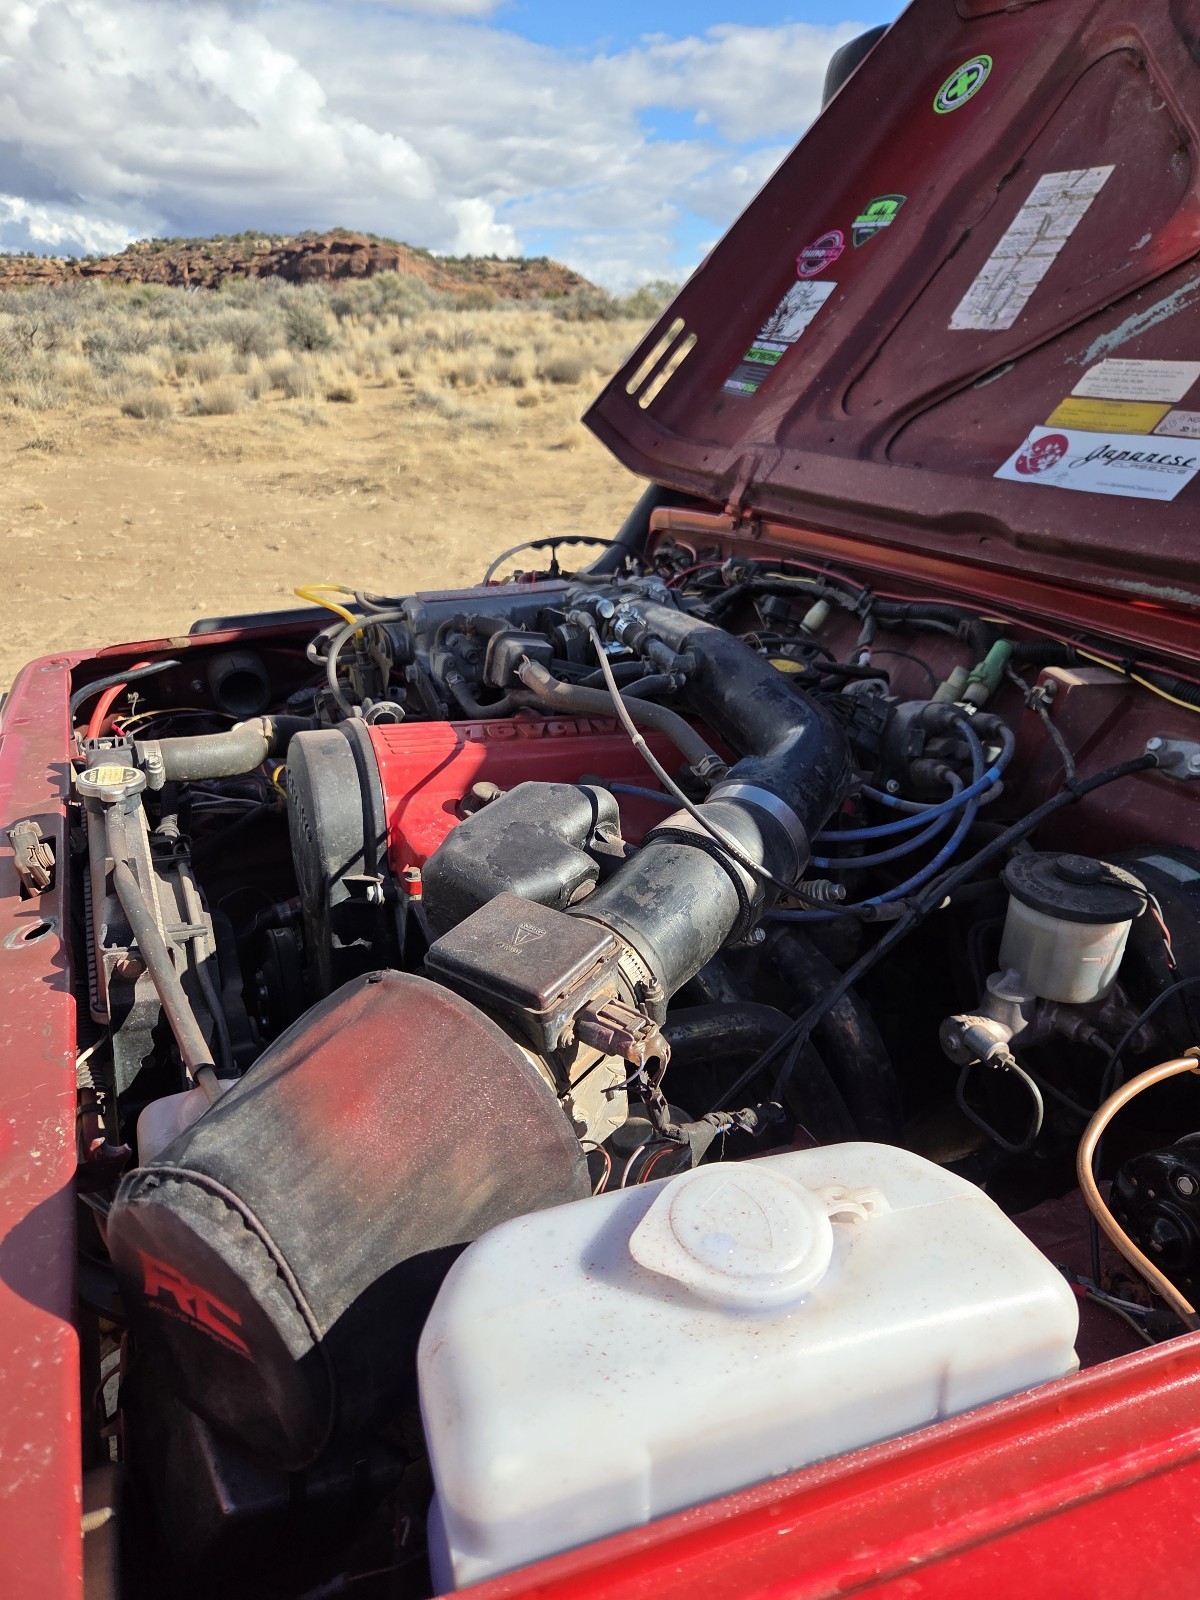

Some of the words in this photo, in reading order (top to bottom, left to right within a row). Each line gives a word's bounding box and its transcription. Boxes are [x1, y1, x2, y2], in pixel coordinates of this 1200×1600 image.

[1069, 444, 1199, 469] Japanese
[1111, 461, 1188, 475] CLASSICS
[137, 1250, 252, 1354] RC
